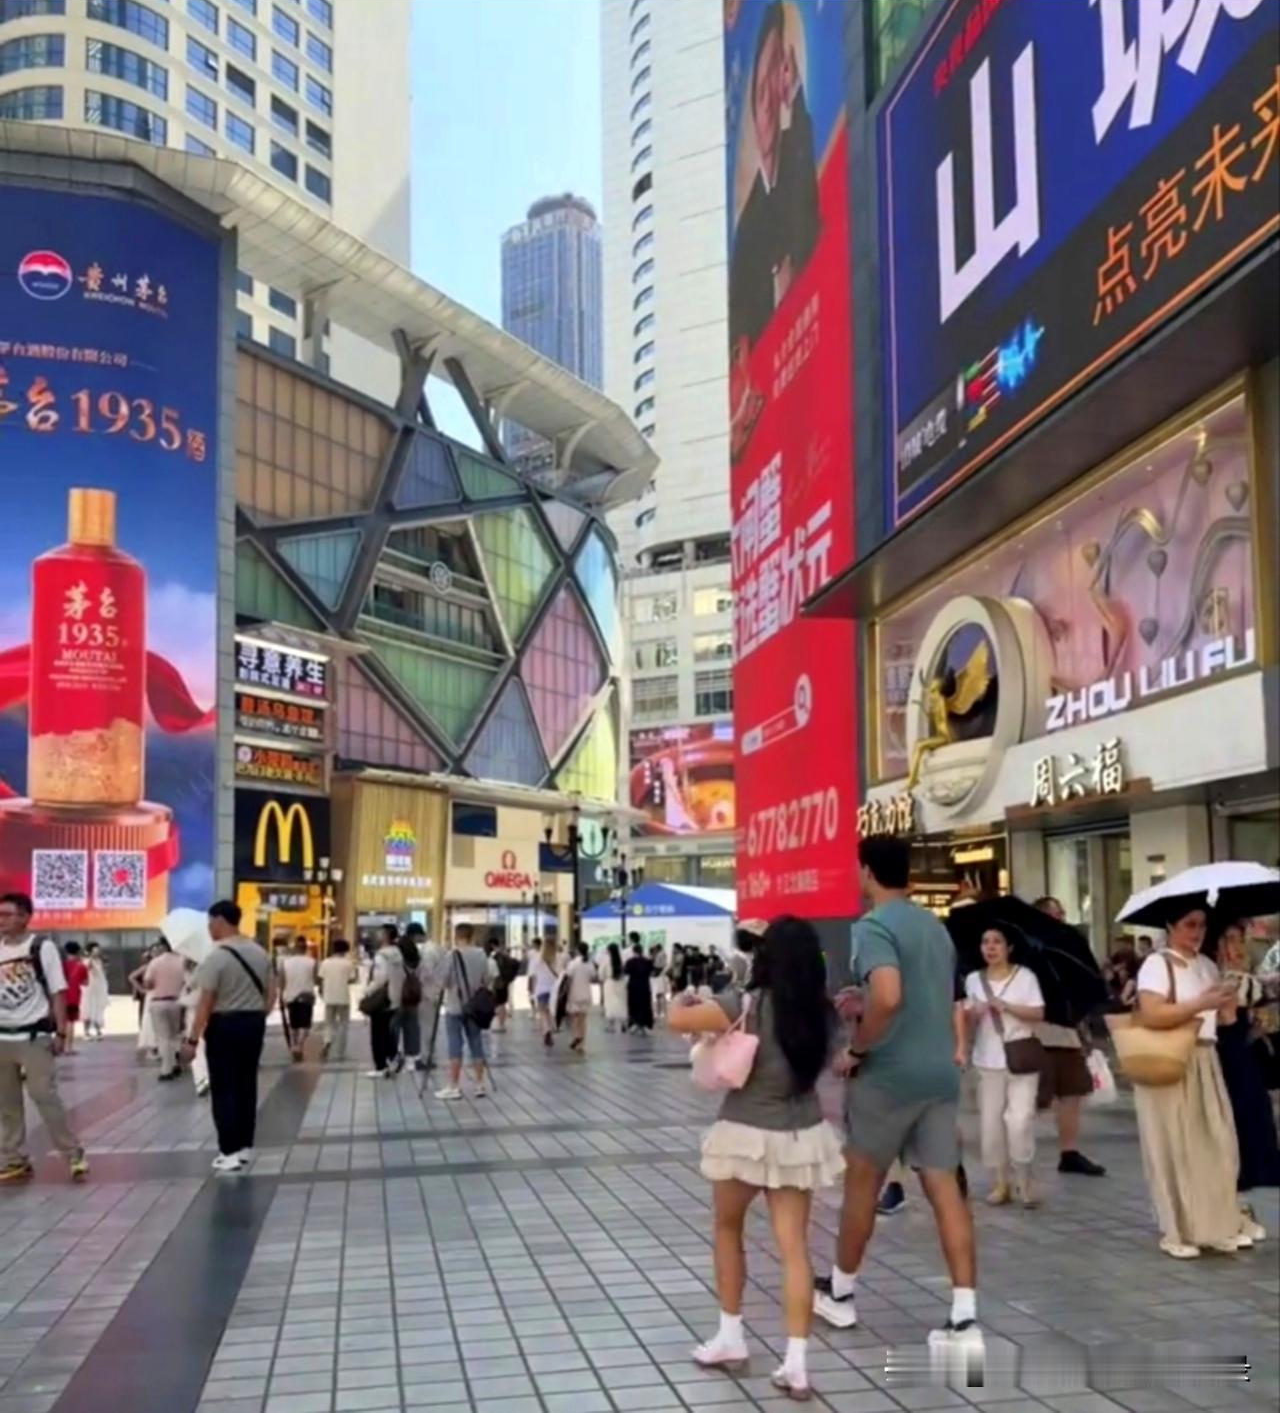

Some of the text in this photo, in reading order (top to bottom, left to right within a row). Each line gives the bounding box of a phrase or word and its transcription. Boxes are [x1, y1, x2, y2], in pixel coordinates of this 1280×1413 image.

[63, 579, 118, 620] 茅台
[59, 622, 119, 647] 1935
[61, 648, 117, 662] MOUTAI
[1045, 628, 1256, 731] ZHOU LIU FU
[1030, 734, 1124, 807] 周六福
[748, 786, 839, 858] 67782770
[484, 871, 532, 889] OMEGA
